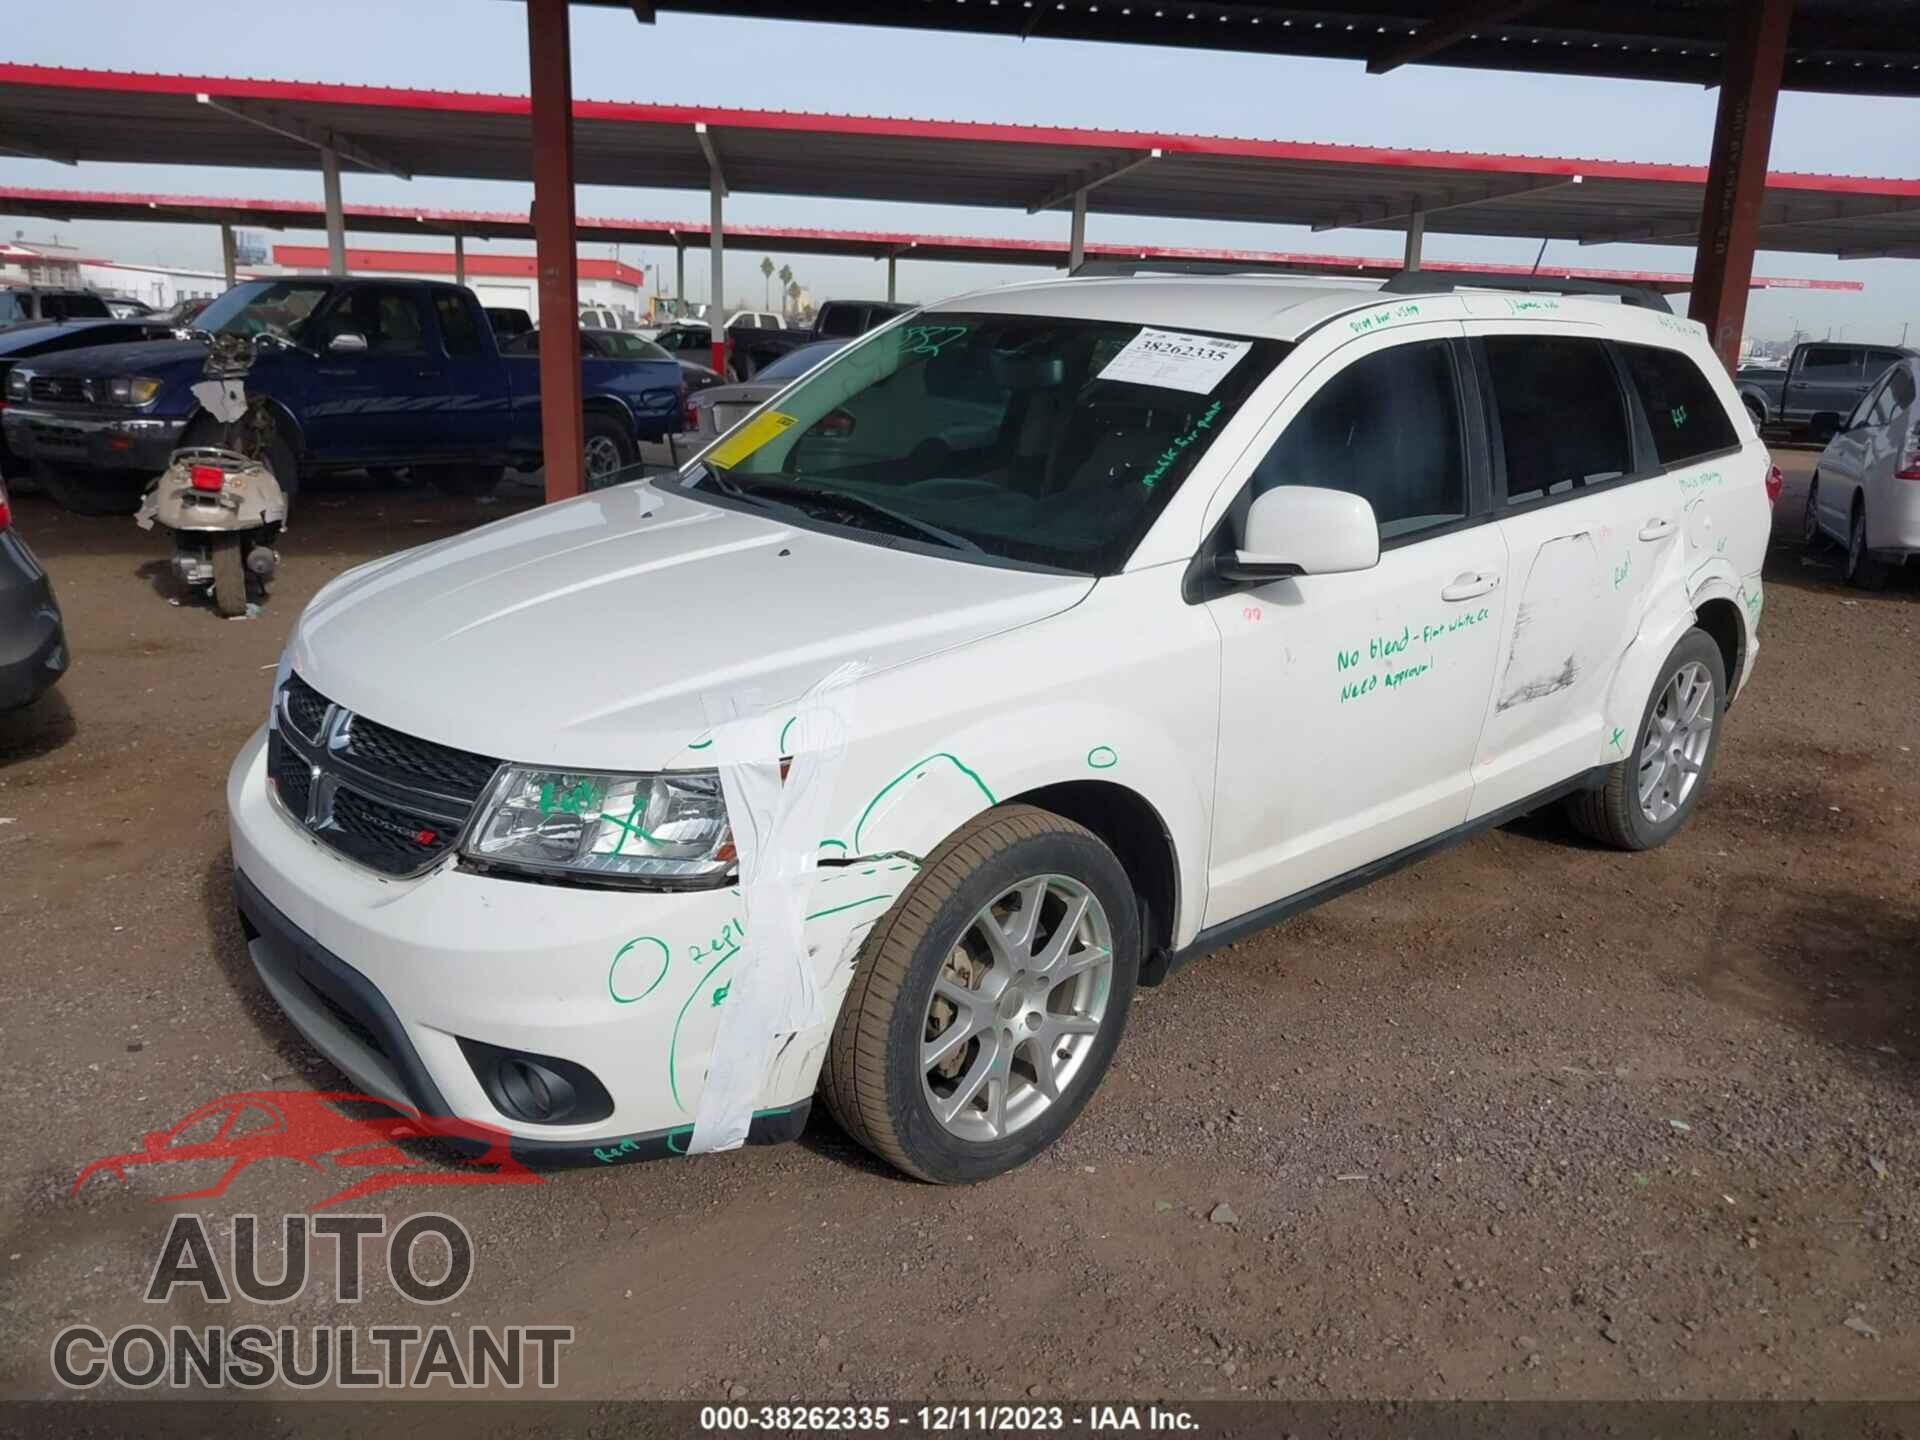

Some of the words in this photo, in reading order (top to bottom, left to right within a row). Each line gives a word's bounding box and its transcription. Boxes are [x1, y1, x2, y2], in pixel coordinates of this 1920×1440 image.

[1137, 340, 1229, 361] 38262335
[1337, 649, 1360, 672] No
[1370, 625, 1410, 659] blend
